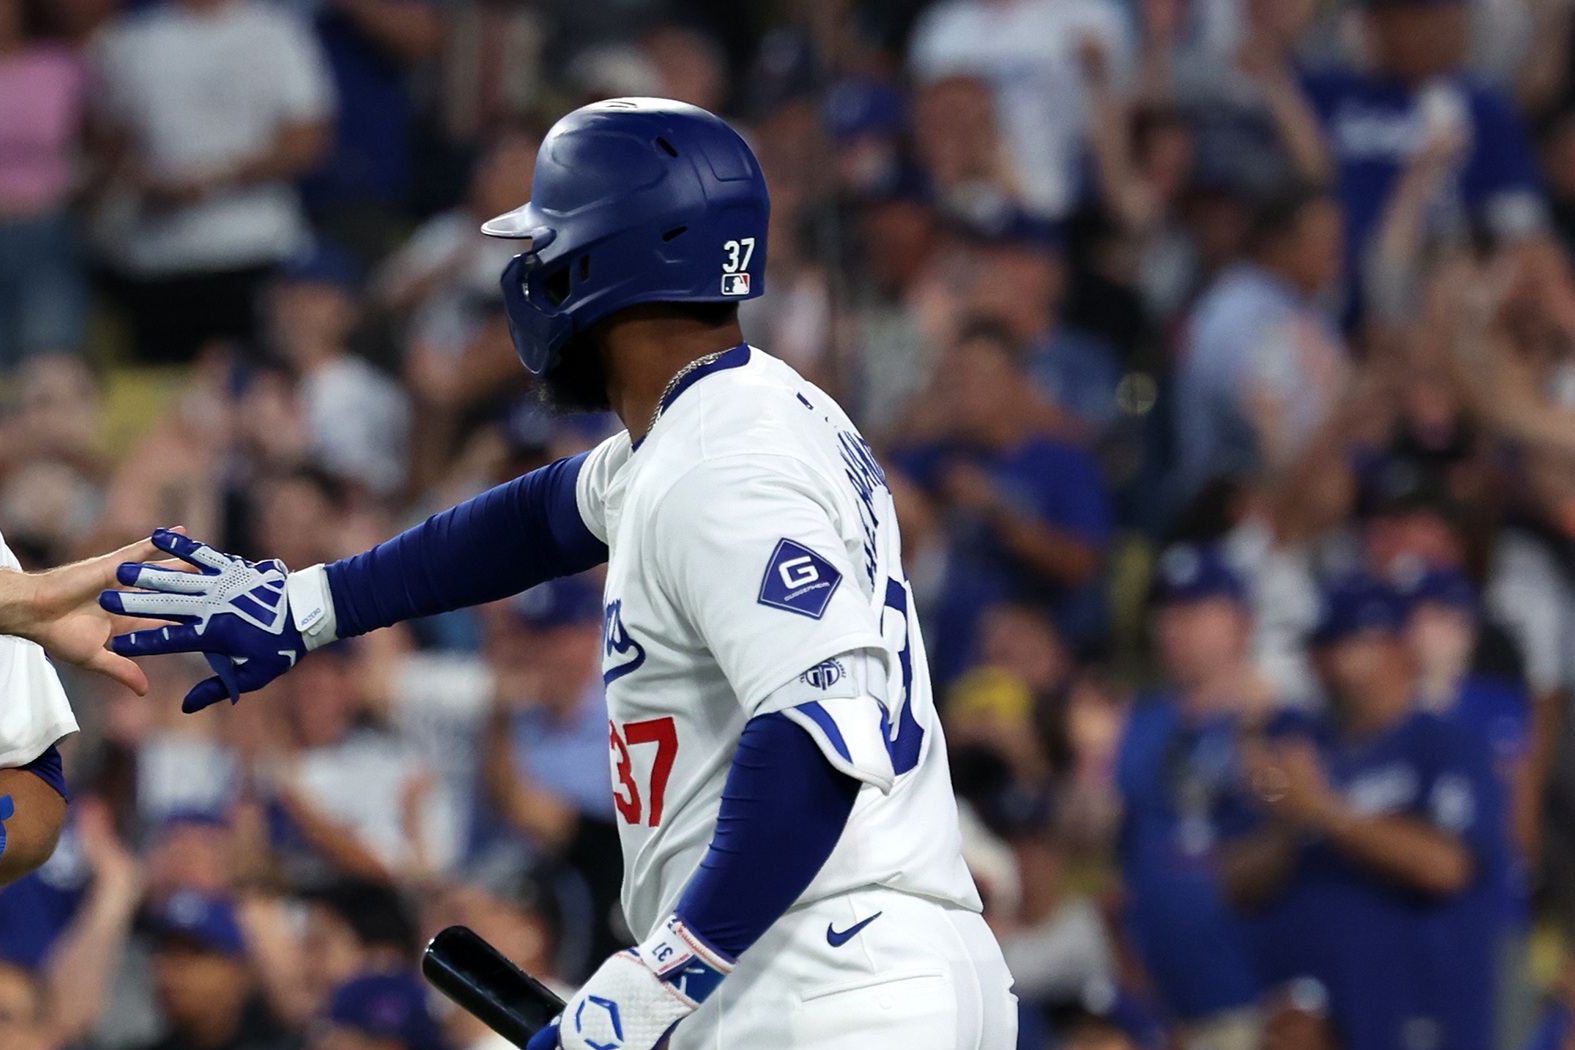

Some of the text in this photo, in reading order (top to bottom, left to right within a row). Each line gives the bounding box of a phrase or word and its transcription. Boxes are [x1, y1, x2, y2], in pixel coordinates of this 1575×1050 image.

[722, 237, 755, 273] 37
[778, 556, 819, 590] G
[609, 716, 679, 828] 37
